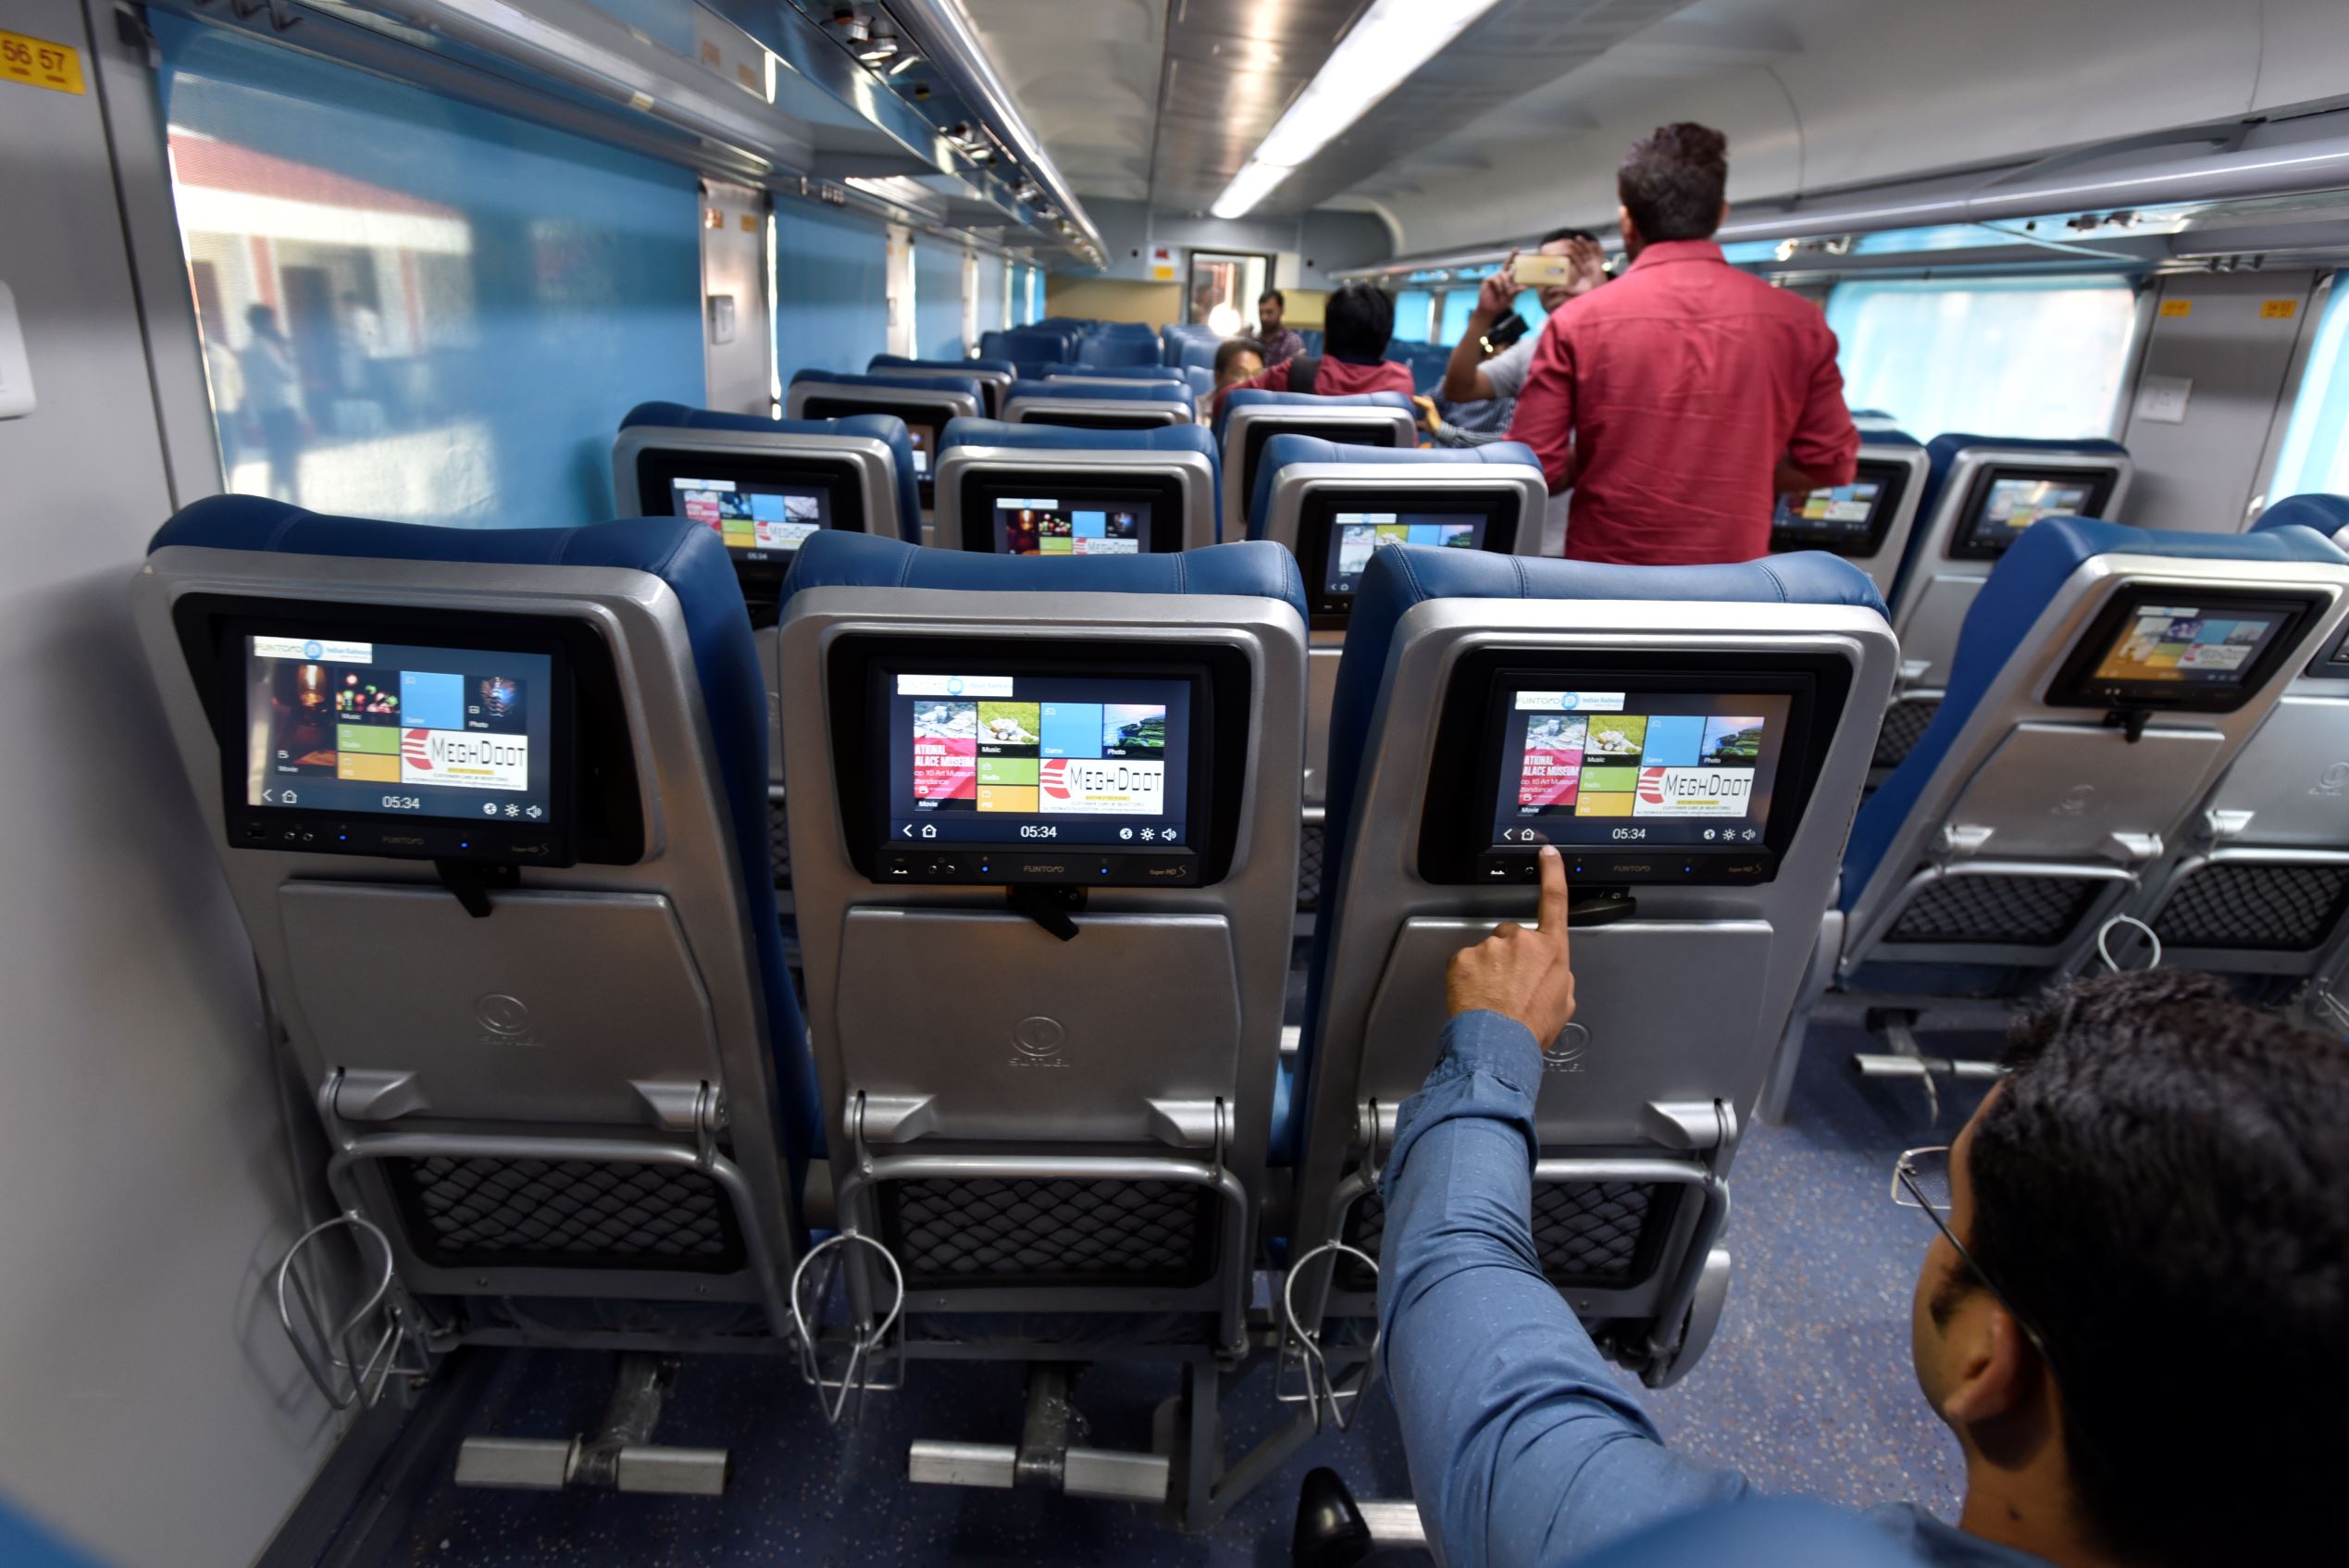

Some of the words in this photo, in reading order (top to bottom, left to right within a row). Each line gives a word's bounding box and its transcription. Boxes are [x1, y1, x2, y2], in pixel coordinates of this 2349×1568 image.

[3, 39, 32, 65] 56
[39, 48, 65, 72] 57
[940, 756, 976, 767] MUSEUM
[1547, 765, 1580, 776] MUSEUM
[382, 796, 420, 809] 05:34
[1020, 826, 1057, 838] 05:34
[1612, 828, 1647, 840] 05:34
